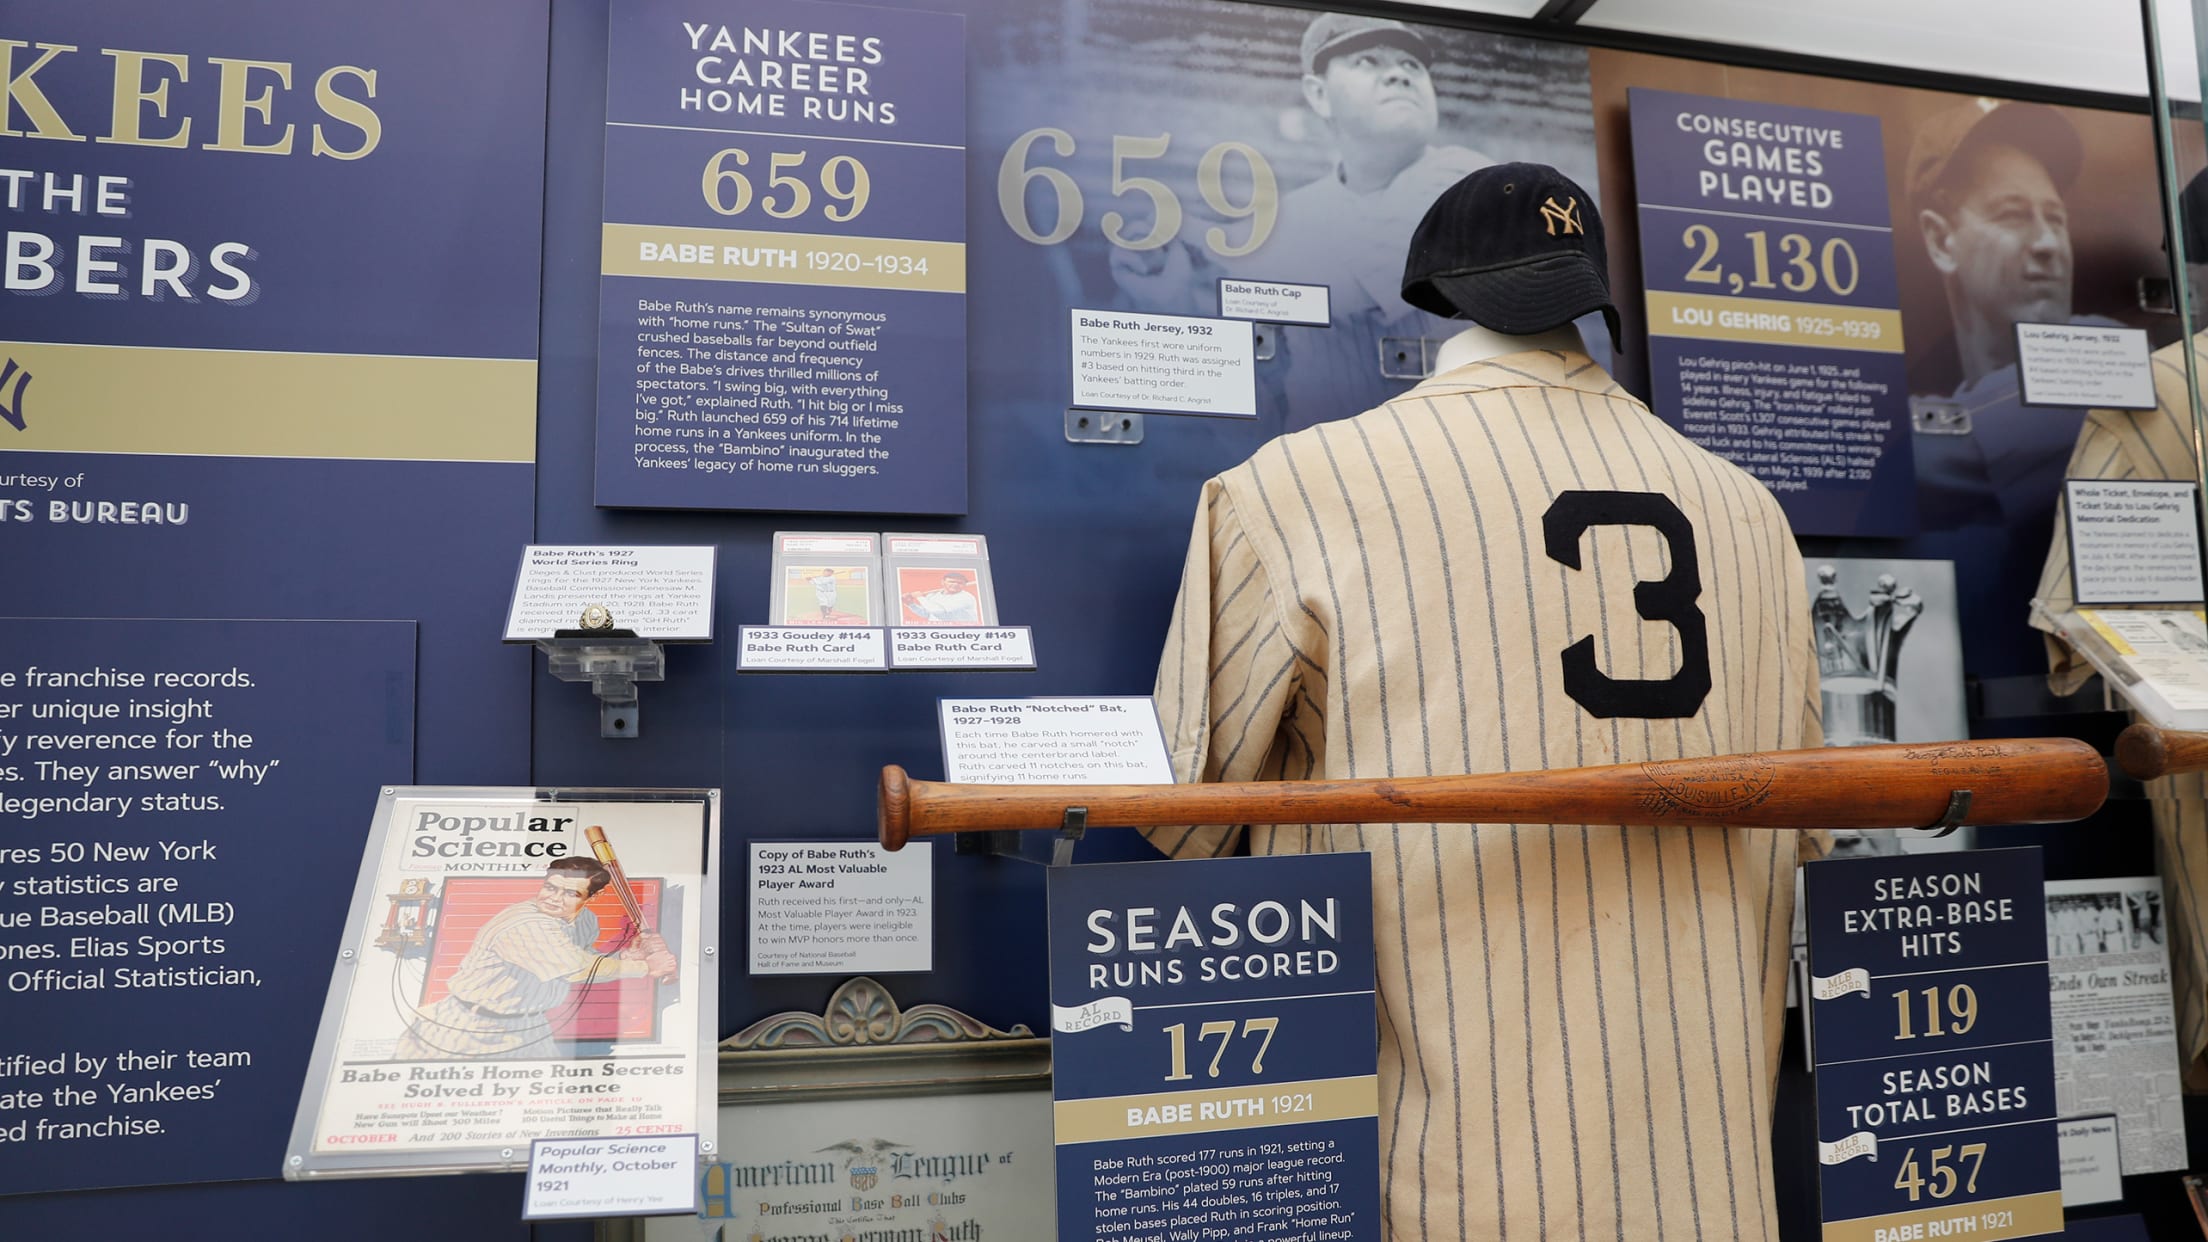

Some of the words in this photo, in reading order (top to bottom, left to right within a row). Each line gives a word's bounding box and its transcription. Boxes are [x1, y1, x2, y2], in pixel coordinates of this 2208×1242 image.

[683, 22, 881, 64] YANKEES
[696, 56, 868, 95] CAREER
[680, 87, 784, 116] HOME
[804, 96, 895, 124] RUNS
[1676, 112, 1842, 149] CONSECUTIVE
[1704, 139, 1822, 176] GAMES
[0, 169, 130, 216] THE
[702, 148, 870, 222] 659
[997, 127, 1279, 257] 659
[1699, 170, 1832, 208] PLAYED
[1540, 196, 1584, 236] NY
[640, 242, 714, 264] BABE
[723, 246, 797, 268] RUTH
[805, 251, 928, 275] 1920–1934
[1683, 224, 1860, 295] 2,130
[1225, 284, 1252, 297] Babe
[1254, 285, 1279, 296] Ruth
[1281, 288, 1301, 300] Cap
[638, 299, 672, 312] Babe
[675, 301, 714, 313] Ruth’s
[717, 305, 752, 315] name
[756, 306, 805, 318] remains
[808, 310, 886, 323] synonymous
[1080, 317, 1110, 328] Babe
[1113, 319, 1140, 330] Ruth
[1143, 322, 1184, 336] Jersey,
[1187, 325, 1212, 335] 1932
[1672, 306, 1713, 326] LOU
[1718, 310, 1791, 332] GEHRIG
[1795, 317, 1880, 338] 1925–1939
[64, 472, 85, 488] of
[2074, 487, 2100, 497] Whole
[2173, 487, 2189, 498] and
[49, 500, 188, 525] BUREAU
[2076, 500, 2101, 511] Ticket
[2103, 501, 2123, 511] Stub
[2124, 502, 2134, 511] to
[2135, 503, 2151, 511] Lou
[2152, 502, 2180, 513] Gehrig
[2076, 514, 2115, 524] Memorial
[2116, 514, 2160, 524] Dedication
[532, 558, 568, 566] World
[571, 558, 608, 566] Series
[611, 558, 638, 567] Ring
[533, 549, 564, 557] Babe
[567, 549, 604, 557] Ruth’s
[609, 549, 634, 557] 1927
[1542, 490, 1712, 719] 3
[748, 630, 778, 640] 1933
[782, 631, 834, 642] Goudey
[838, 631, 871, 641] #144
[896, 630, 926, 640] 1933
[930, 631, 980, 641] Goudey
[985, 630, 1016, 640] #149
[747, 642, 782, 652] Babe
[786, 643, 818, 653] Ruth
[822, 643, 855, 653] Card
[897, 642, 931, 652] Babe
[935, 642, 967, 652] Ruth
[970, 642, 1002, 652] Card
[25, 666, 145, 687] franchise
[154, 667, 255, 687] records.
[951, 704, 986, 713] Babe
[990, 703, 1022, 713] Ruth
[1025, 703, 1094, 713] “Notched”
[1099, 703, 1126, 713] Bat,
[953, 715, 1021, 725] 1927–1928
[954, 730, 981, 739] Each
[984, 731, 1008, 739] time
[1011, 729, 1039, 739] Babe
[1041, 729, 1067, 738] Ruth
[1069, 729, 1118, 738] homered
[1120, 729, 1143, 737] with
[415, 811, 575, 837] Popular
[412, 836, 568, 858] Science
[758, 849, 788, 862] Copy
[791, 849, 804, 859] of
[807, 848, 836, 859] Babe
[839, 848, 875, 859] Ruth’s
[444, 862, 532, 872] MONTHLY
[759, 864, 784, 874] 1923
[787, 863, 803, 874] AL
[806, 863, 835, 874] Most
[838, 863, 887, 874] Valuable
[758, 879, 795, 891] Player
[798, 878, 834, 889] Award
[1874, 872, 1980, 901] SEASON
[1087, 898, 1335, 953] SEASON
[1844, 898, 2013, 933] EXTRA-BASE
[1902, 931, 1961, 957] HITS
[1089, 959, 1183, 988] RUNS
[1200, 950, 1337, 981] SCORED
[1822, 981, 1862, 998] RECORD
[1828, 972, 1852, 988] MLB
[1065, 1011, 1120, 1030] RECORD
[1080, 1003, 1101, 1019] AL
[1892, 983, 1977, 1040] 119
[1162, 1017, 1279, 1081] 177
[340, 1068, 401, 1083] Babe
[409, 1066, 474, 1080] Ruth’s
[481, 1065, 543, 1079] Home
[551, 1064, 593, 1077] Run
[601, 1062, 683, 1076] Secrets
[1883, 1061, 1990, 1095] SEASON
[404, 1083, 483, 1098] Solved
[492, 1082, 520, 1098] by
[529, 1081, 621, 1095] Science
[1127, 1103, 1192, 1126] BABE
[1200, 1097, 1264, 1120] RUTH
[1271, 1093, 1312, 1113] 1921
[1846, 1097, 1936, 1128] TOTAL
[1946, 1086, 2027, 1116] BASES
[327, 1133, 397, 1144] OCTOBER
[519, 1129, 543, 1139] New
[545, 1126, 600, 1138] Inventions
[615, 1124, 633, 1136] 25
[636, 1123, 683, 1135] CENTS
[540, 1145, 603, 1159] Popular
[607, 1143, 666, 1154] Science
[1828, 1145, 1868, 1162] RECORD
[1834, 1135, 1859, 1153] MLB
[538, 1161, 607, 1175] Monthly,
[612, 1159, 677, 1171] October
[1894, 1142, 1987, 1201] 457
[536, 1180, 569, 1192] 1921
[1874, 1222, 1924, 1242] BABE
[1928, 1215, 1976, 1237] RUTH
[1981, 1211, 2012, 1229] 1921
